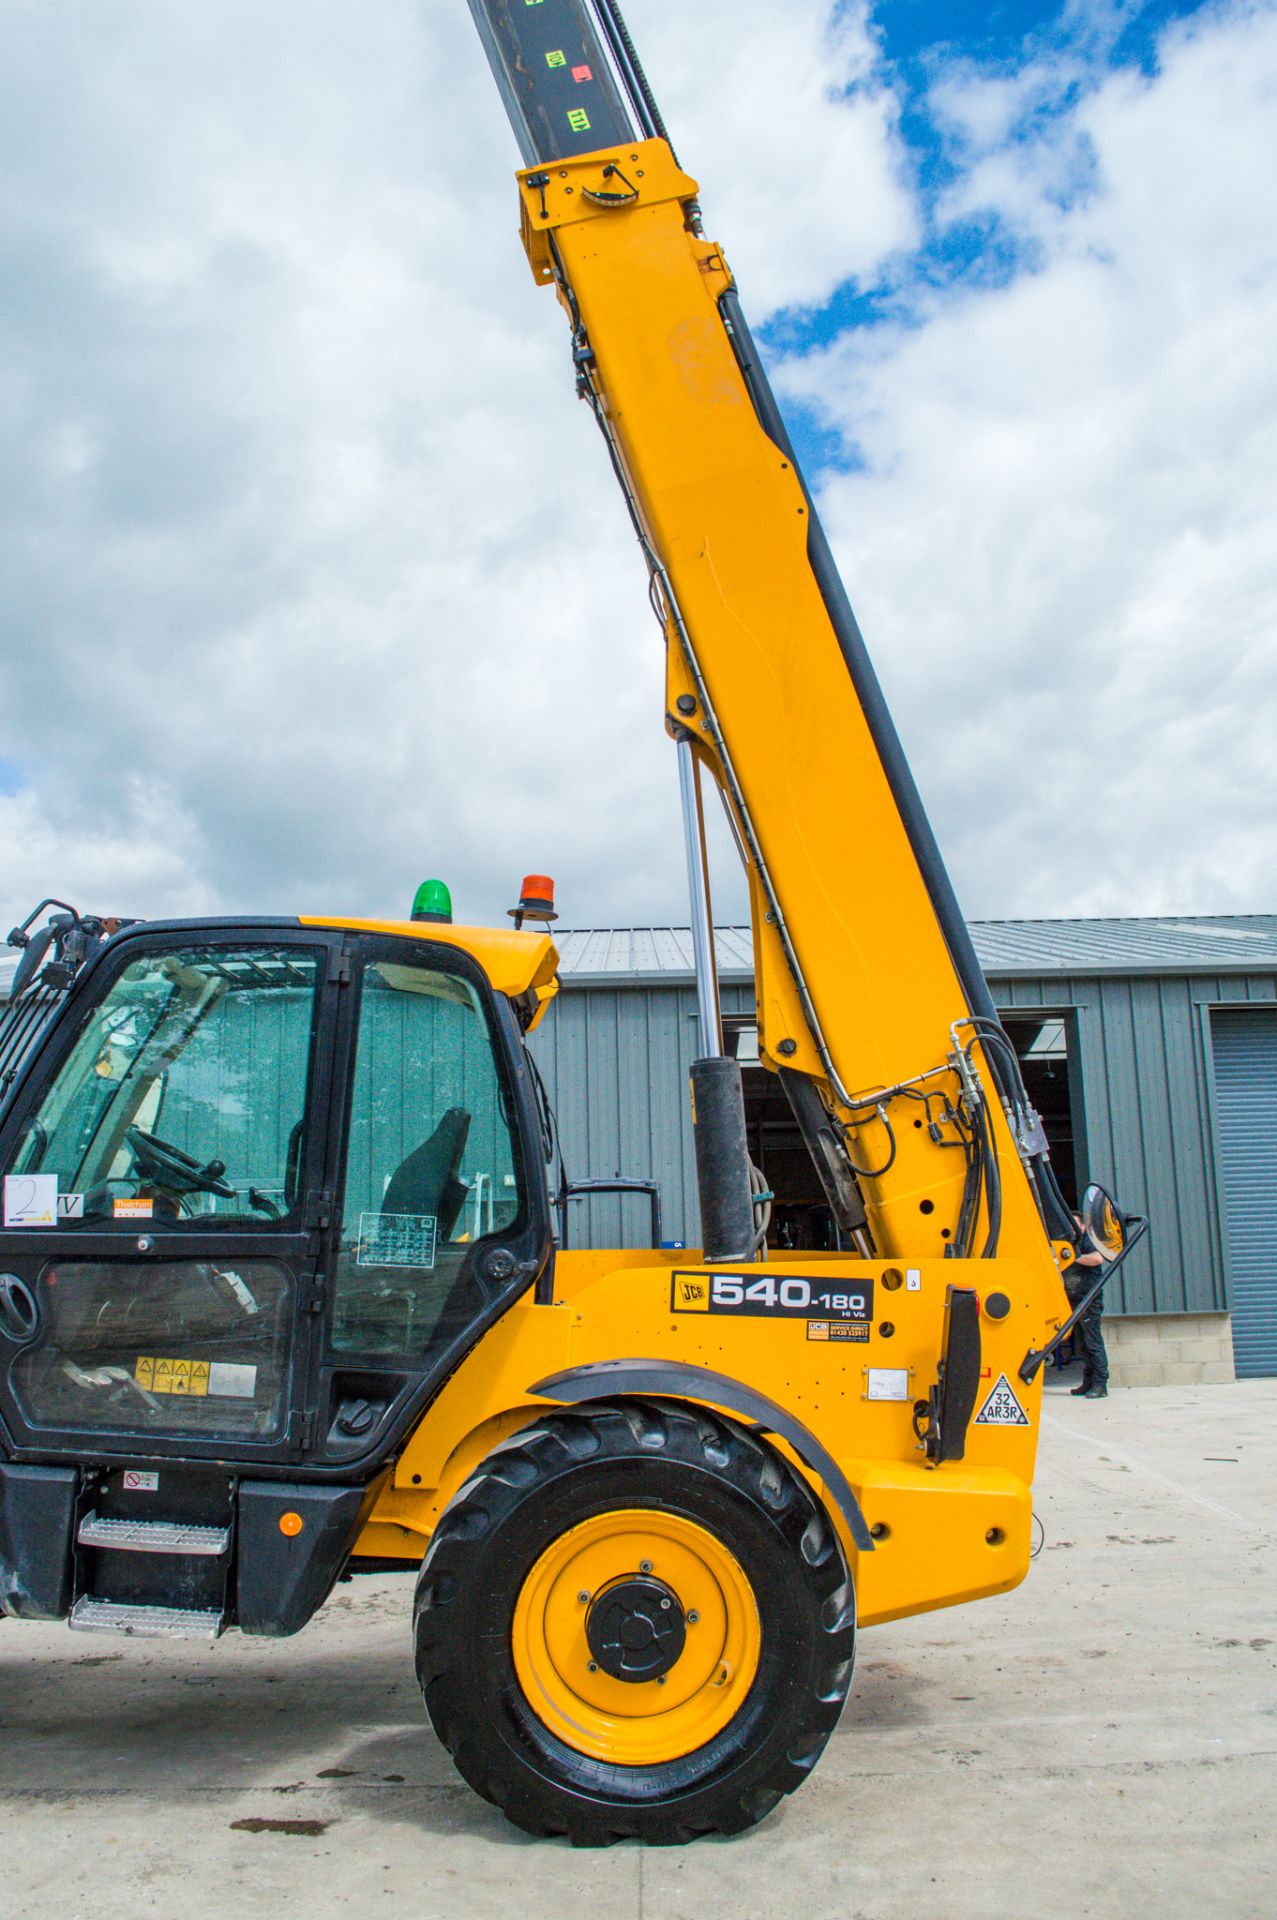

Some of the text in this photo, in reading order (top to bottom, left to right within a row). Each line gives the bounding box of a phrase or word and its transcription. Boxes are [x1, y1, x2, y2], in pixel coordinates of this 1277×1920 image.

[570, 111, 585, 124] 11
[15, 1179, 37, 1215] 2
[683, 1275, 866, 1310] JCB 540-180
[995, 1393, 1010, 1406] 32
[987, 1406, 1018, 1419] AR3R
